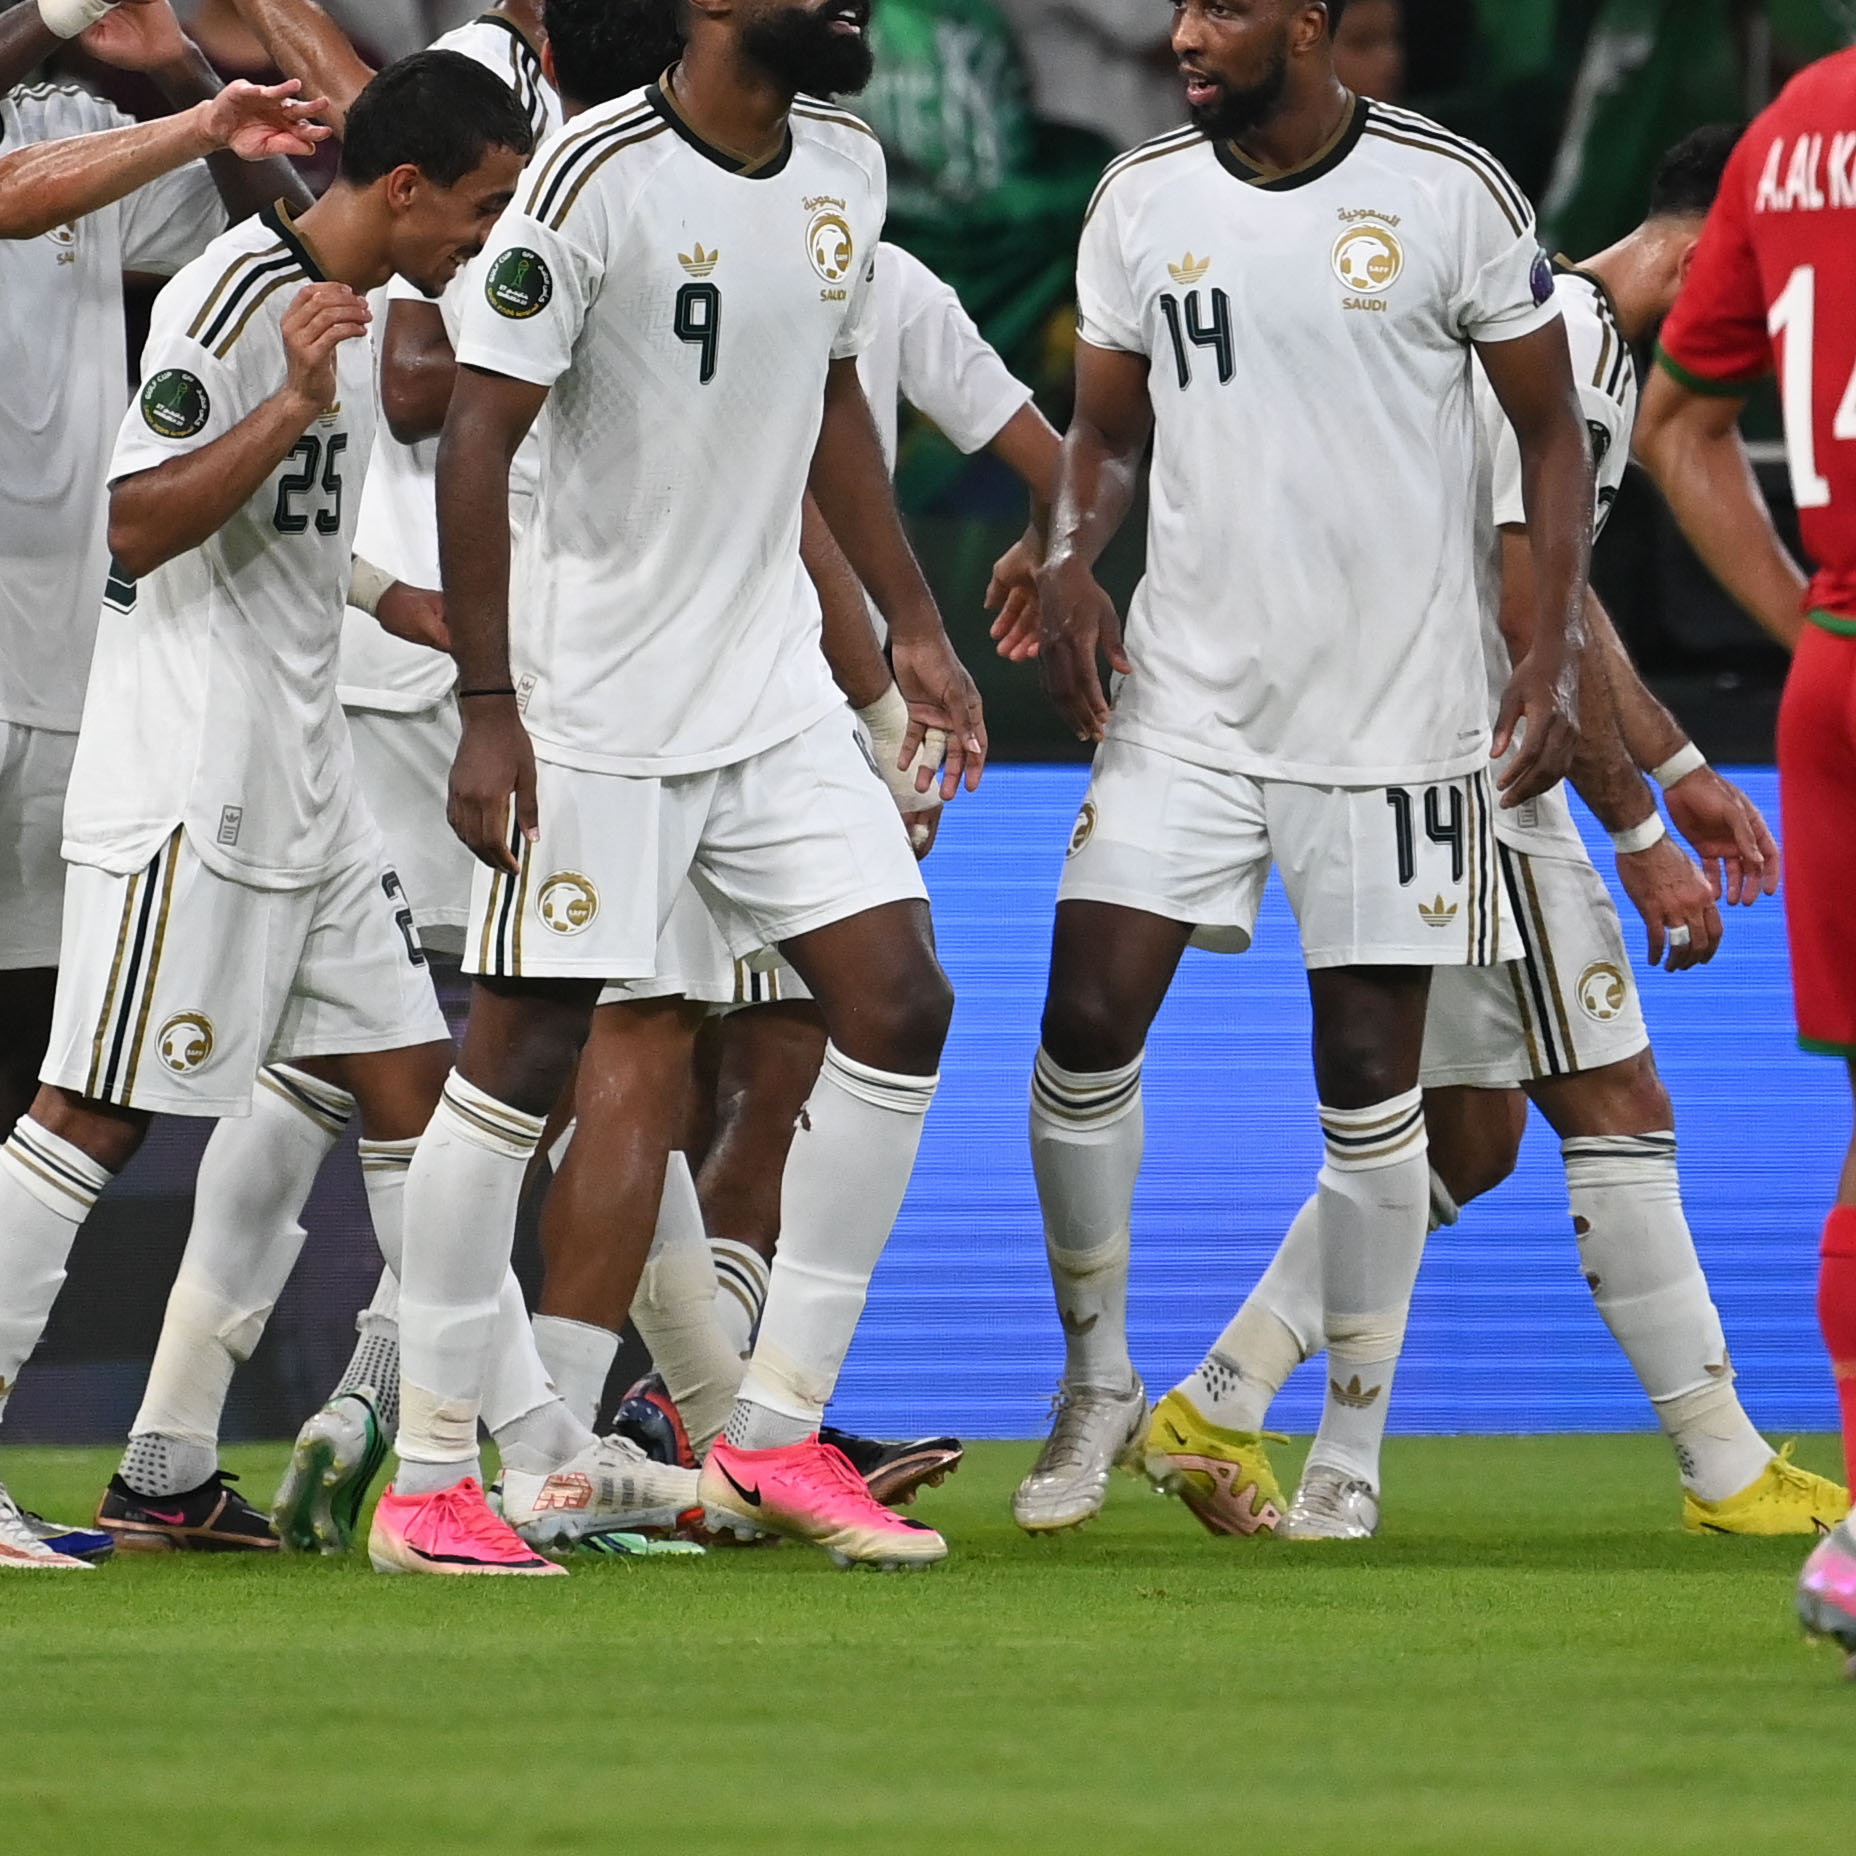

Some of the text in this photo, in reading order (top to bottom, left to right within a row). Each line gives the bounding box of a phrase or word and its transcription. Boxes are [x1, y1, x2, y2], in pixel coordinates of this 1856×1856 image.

[1336, 208, 1401, 228] السعودية
[674, 282, 721, 385] 9
[1160, 287, 1237, 392] 14
[1342, 296, 1387, 312] SAUDI
[273, 433, 349, 535] 25
[1386, 785, 1465, 887] 14
